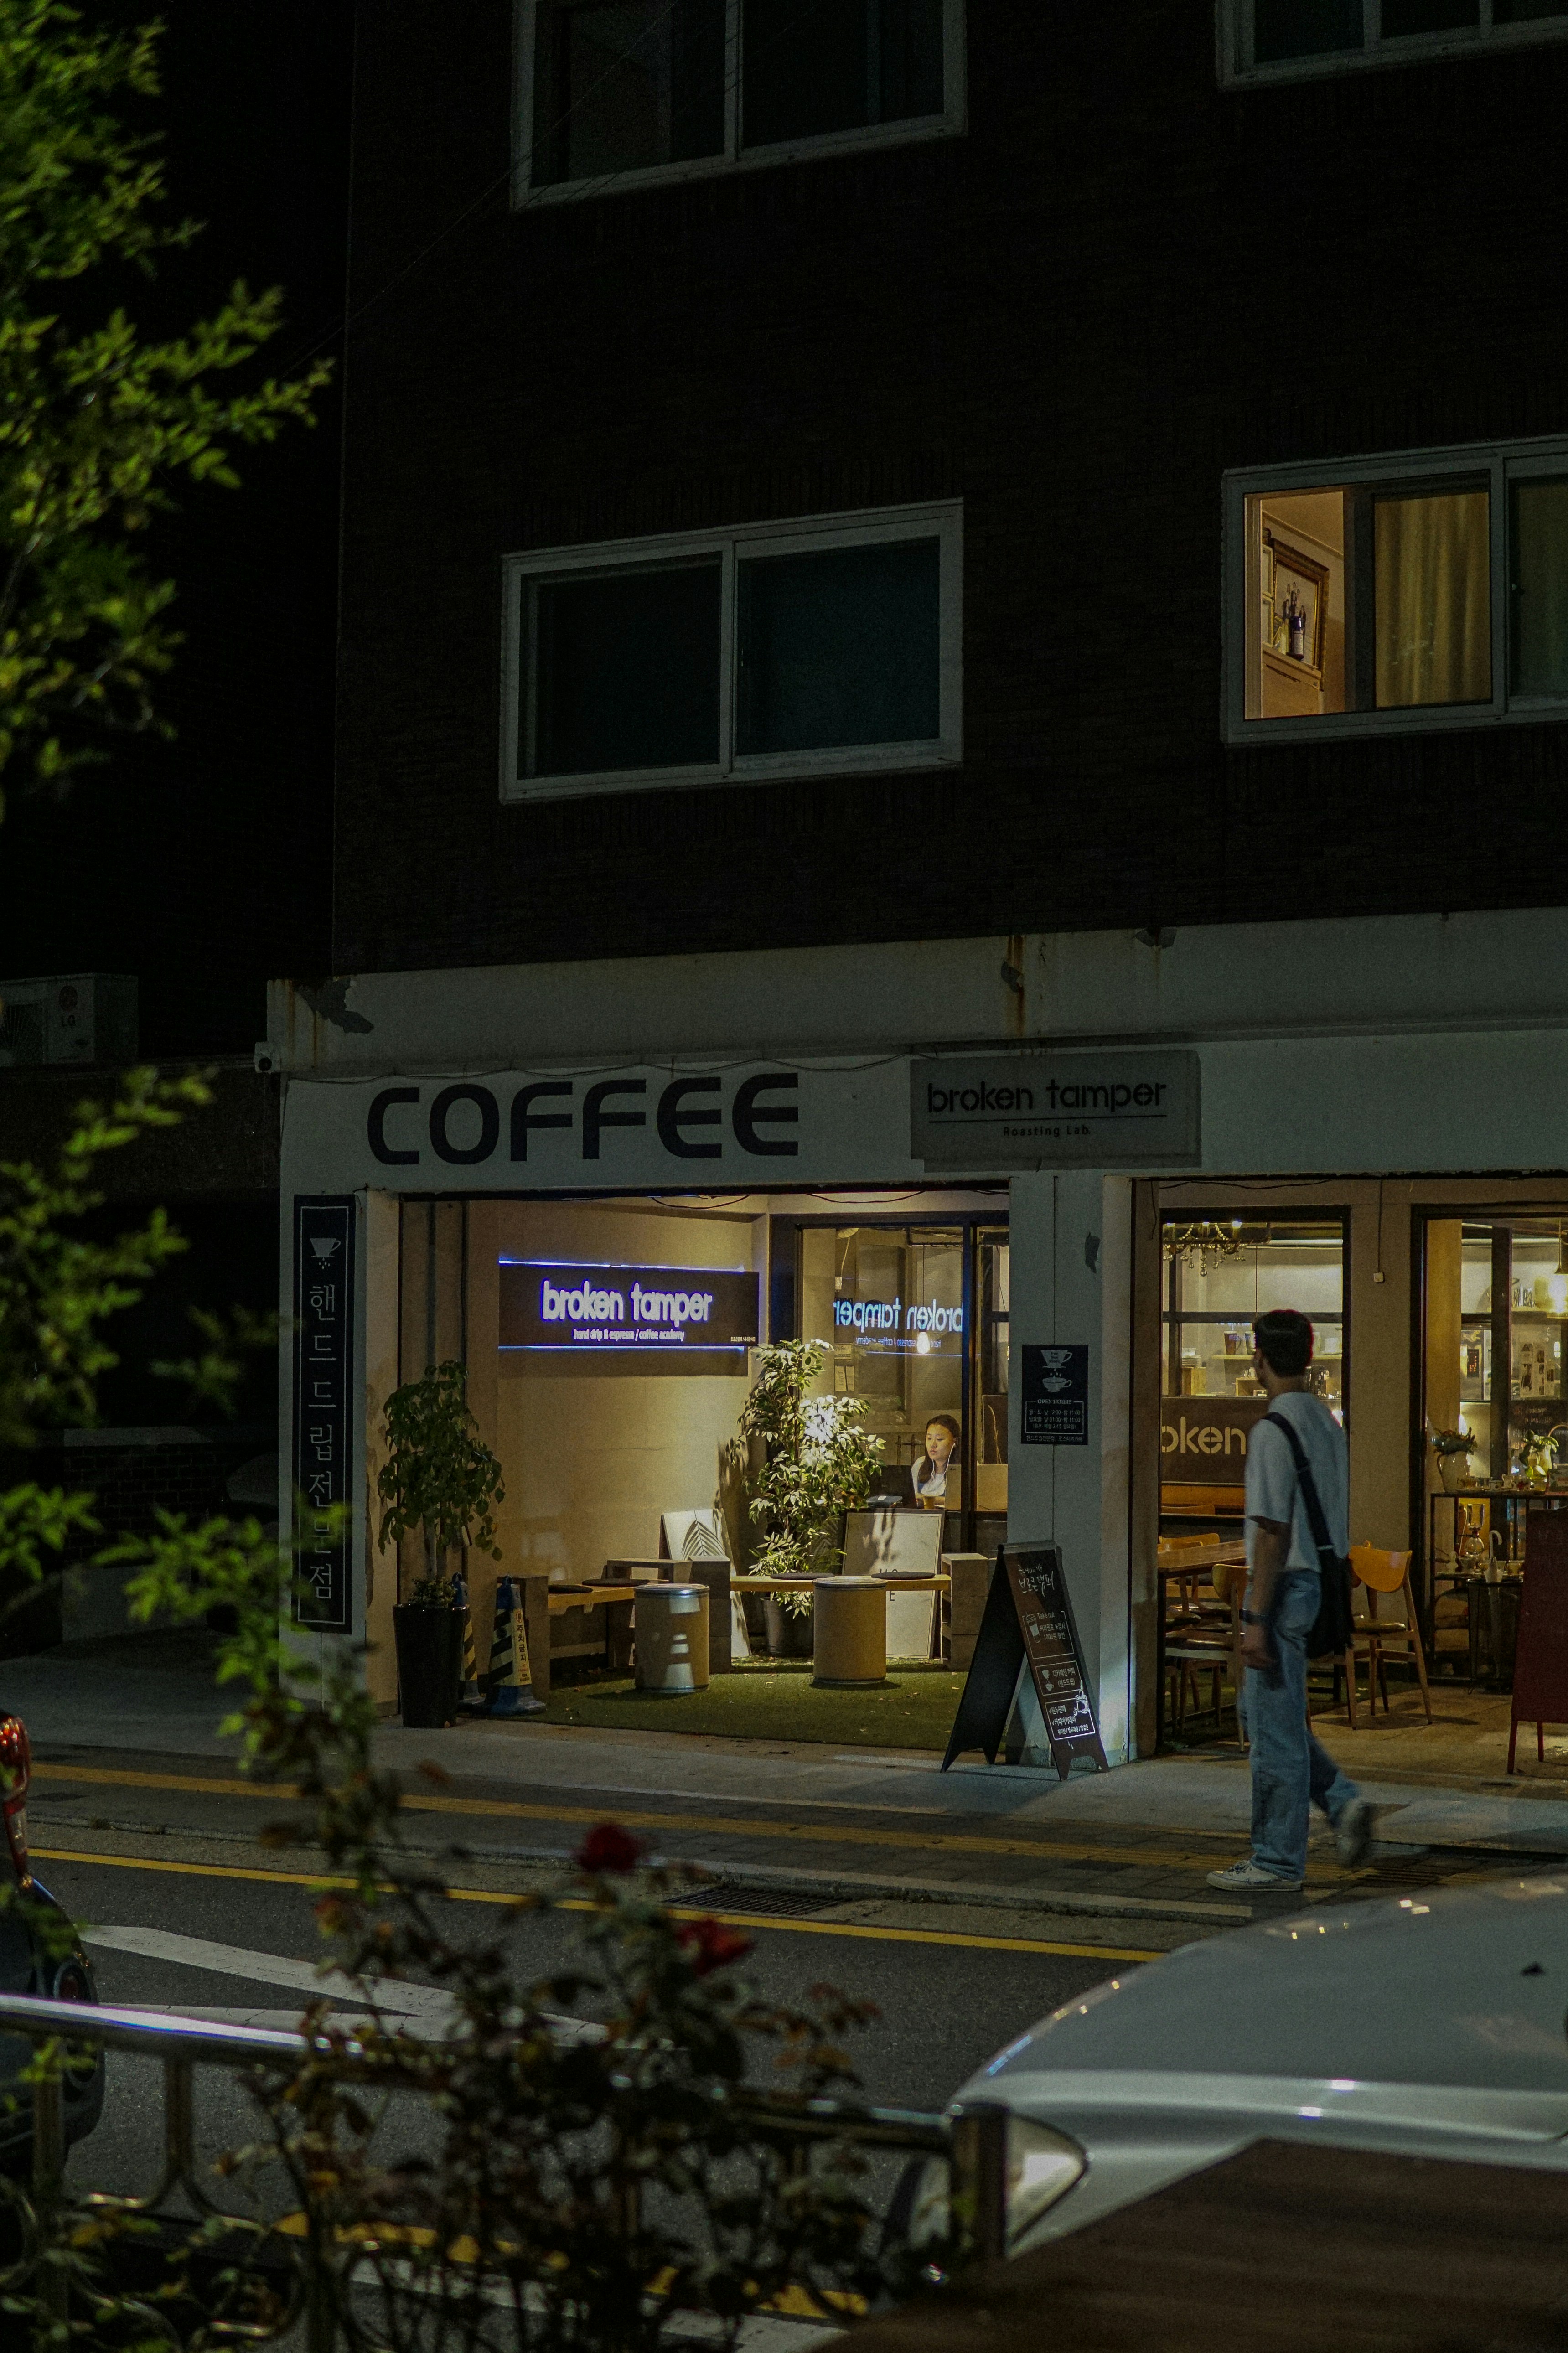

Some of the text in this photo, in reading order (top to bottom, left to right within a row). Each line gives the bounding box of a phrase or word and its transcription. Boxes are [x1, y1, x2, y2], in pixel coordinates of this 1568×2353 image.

[928, 1079, 1167, 1112] broken tamper
[367, 1072, 798, 1165] COFFEE
[1004, 1125, 1090, 1138] Roasting Lab.
[542, 1280, 713, 1327] broken tamper
[574, 1328, 590, 1340] hand
[590, 1328, 603, 1342] drip
[609, 1330, 635, 1342] espresso
[639, 1329, 658, 1340] coffee
[659, 1329, 685, 1342] academy
[517, 1624, 526, 1662] 주차금지
